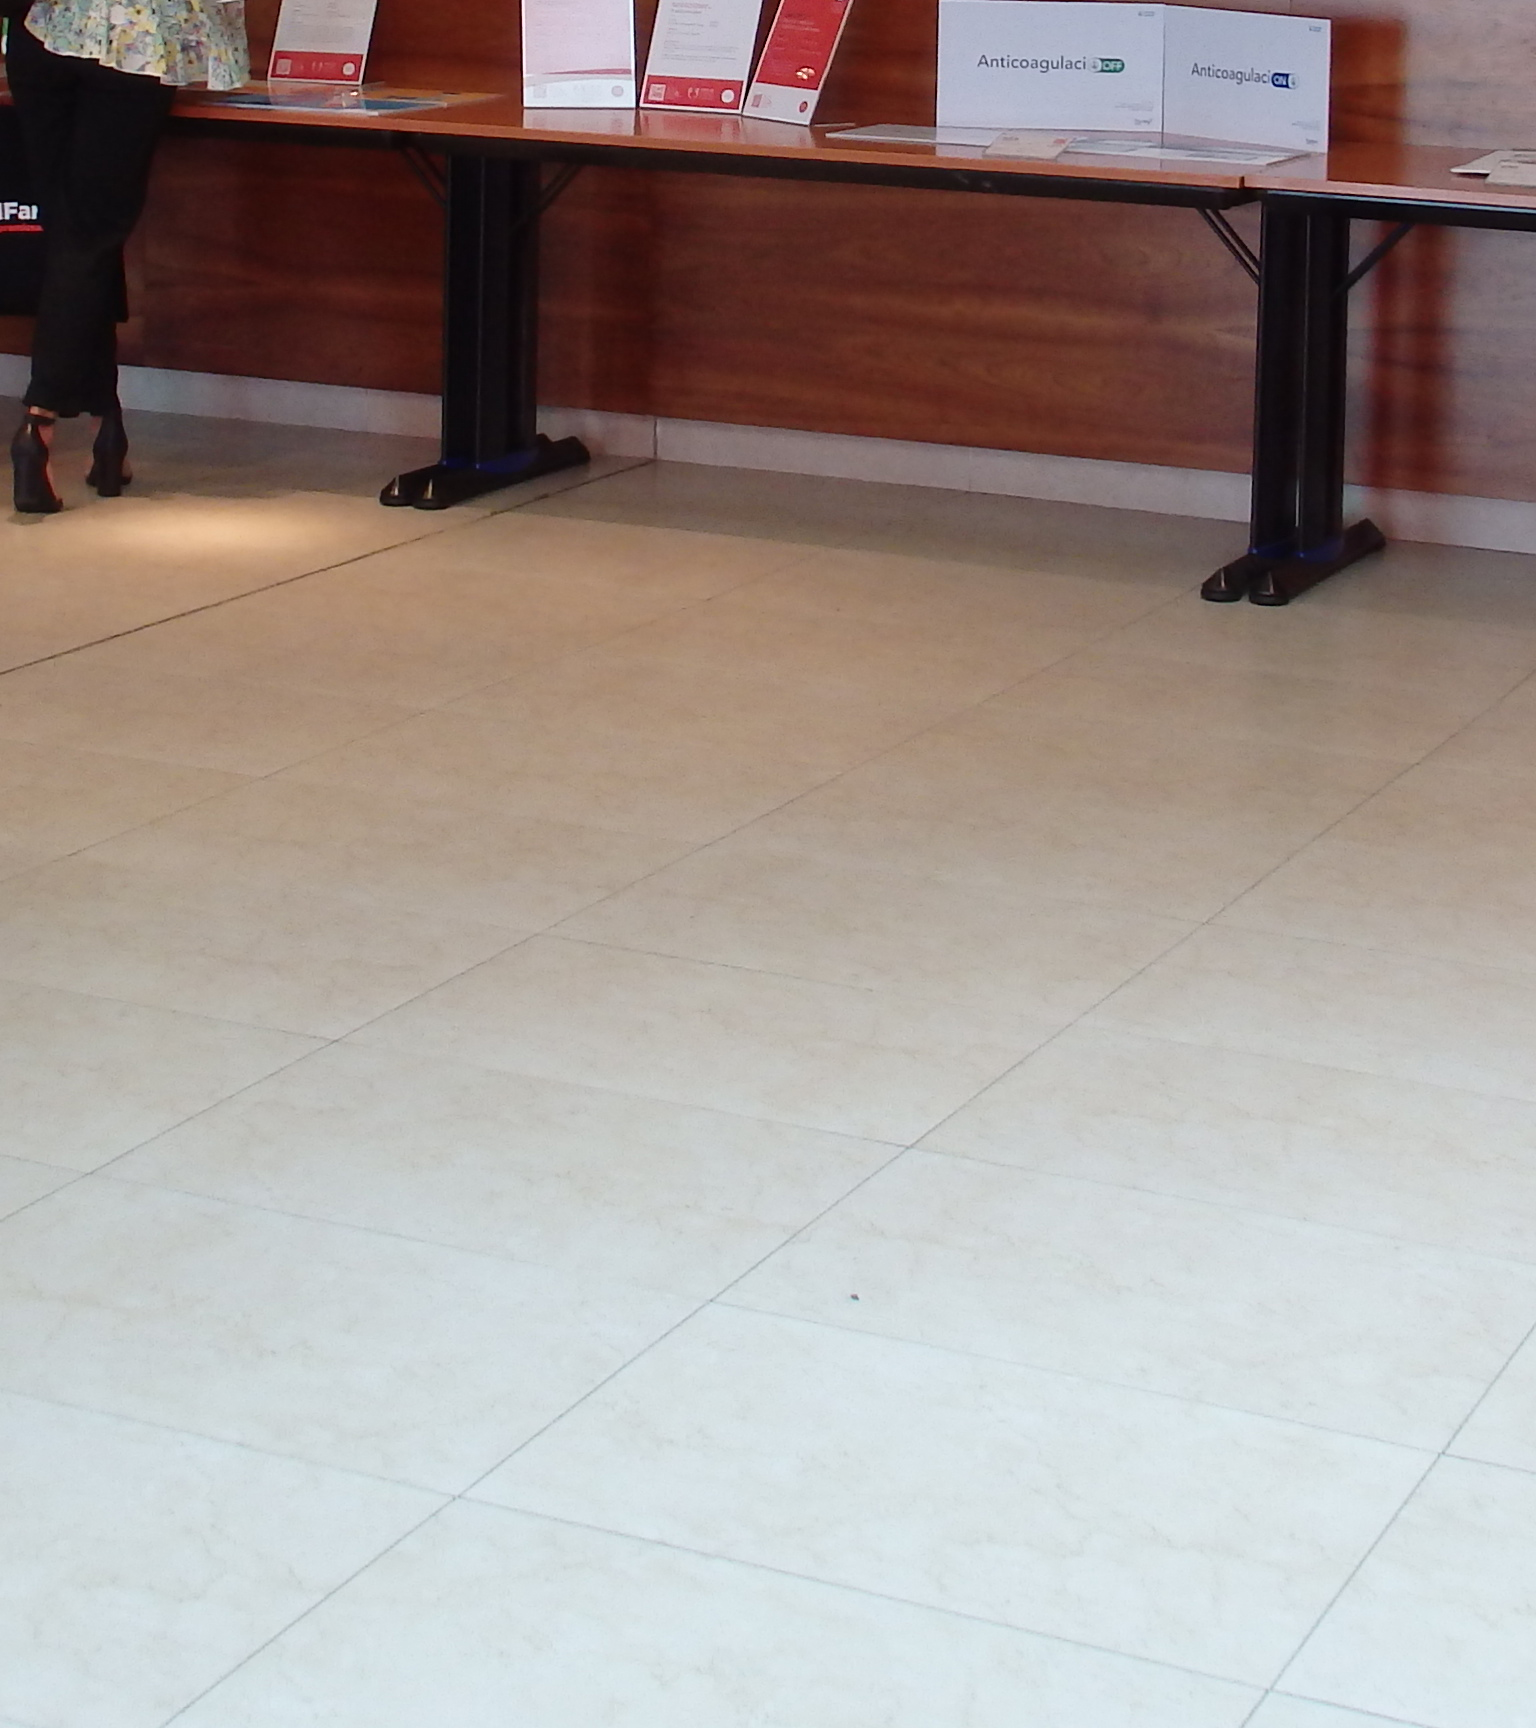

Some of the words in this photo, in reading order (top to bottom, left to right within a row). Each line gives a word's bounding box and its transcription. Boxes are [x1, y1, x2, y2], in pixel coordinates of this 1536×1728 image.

[977, 54, 1087, 74] Anticoagulaci
[1102, 60, 1124, 71] OFF
[1191, 62, 1271, 86] Anticoagulaci
